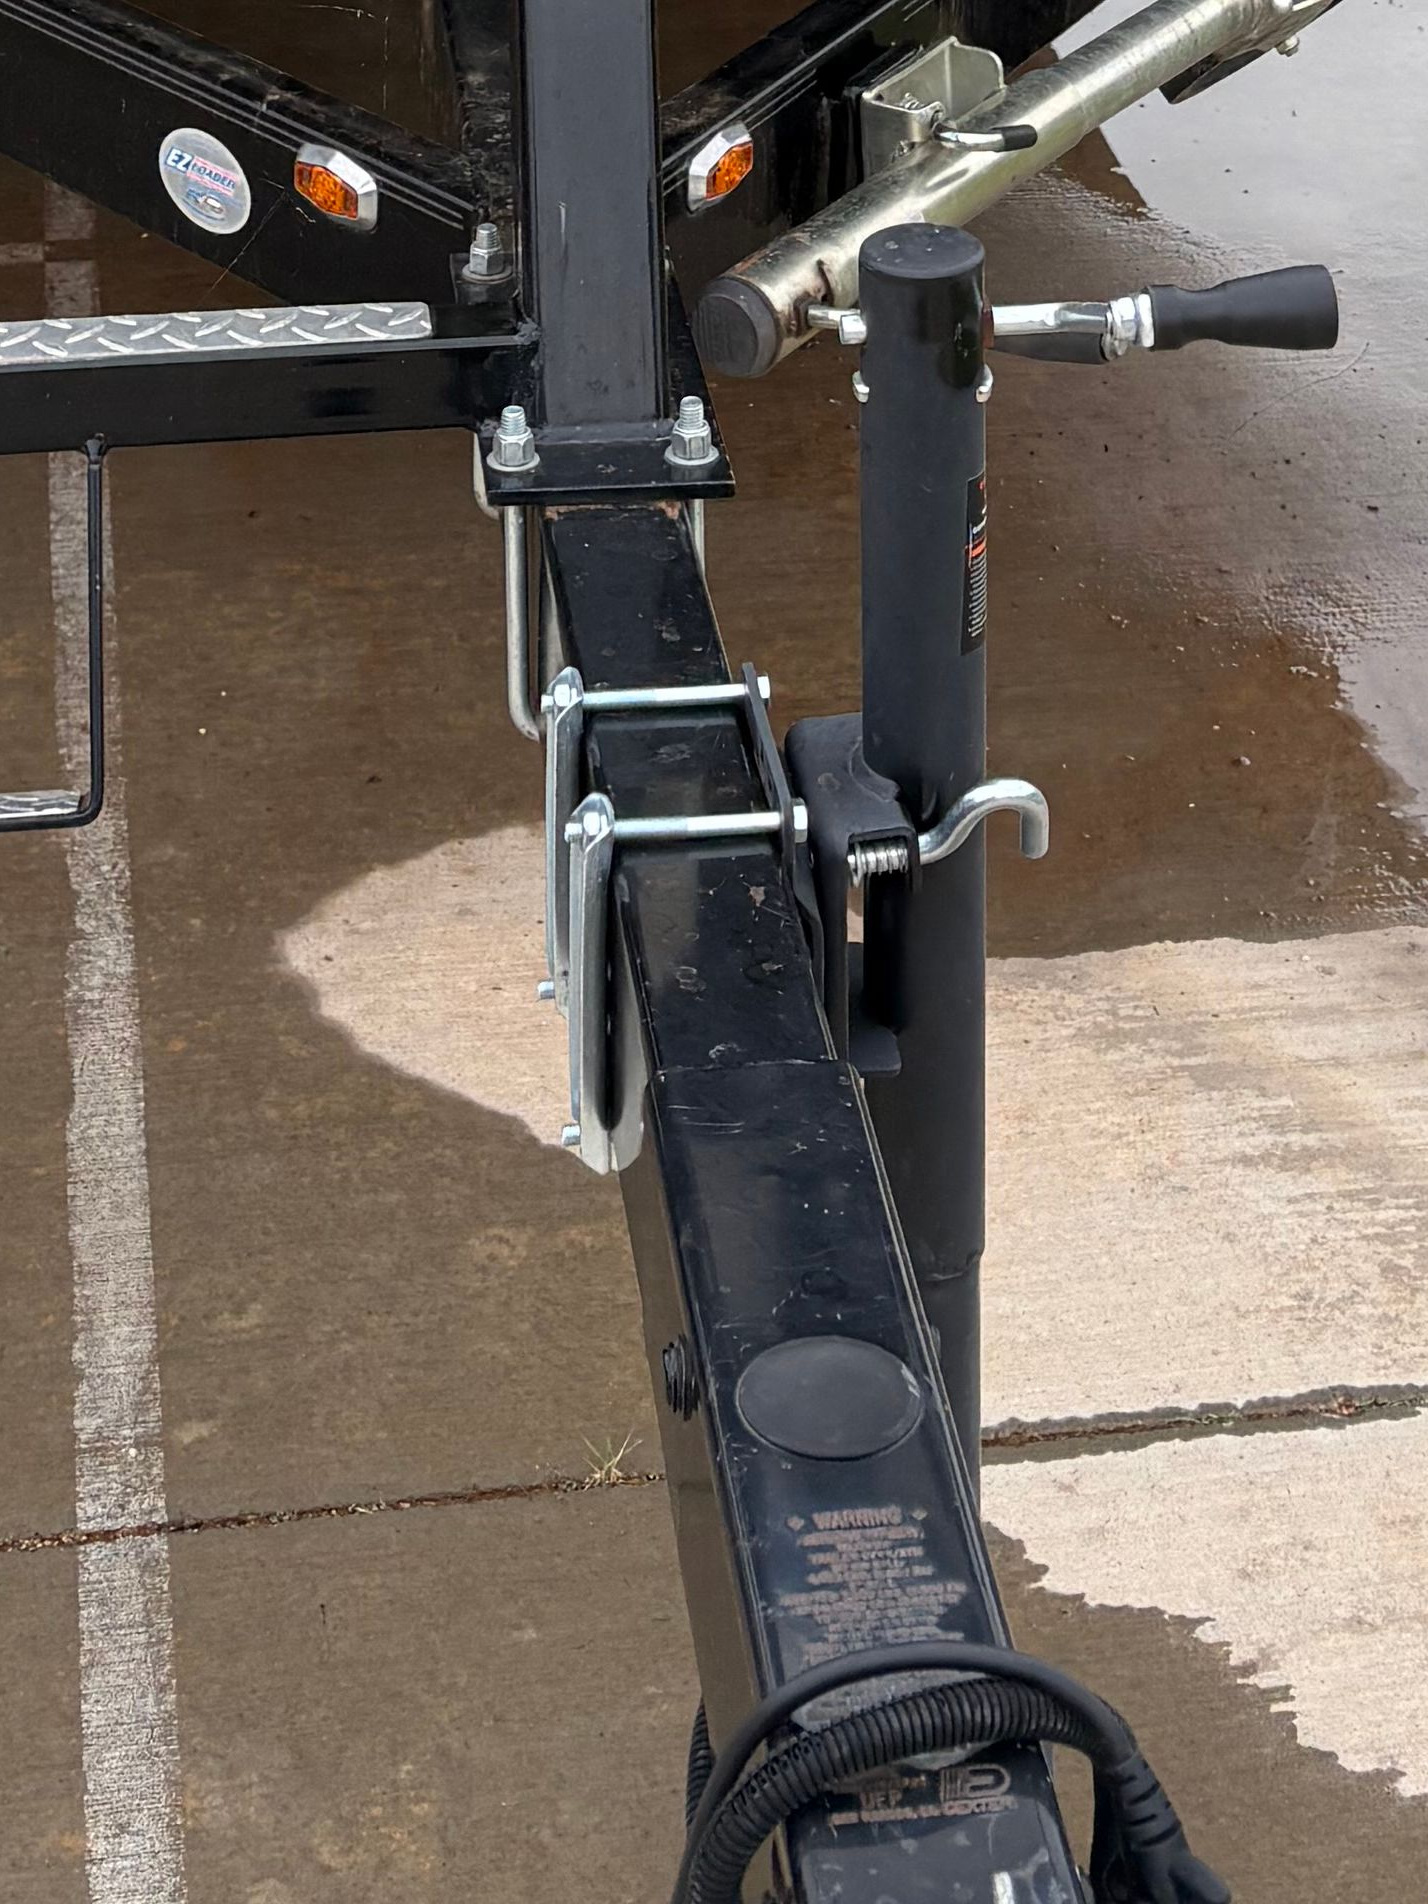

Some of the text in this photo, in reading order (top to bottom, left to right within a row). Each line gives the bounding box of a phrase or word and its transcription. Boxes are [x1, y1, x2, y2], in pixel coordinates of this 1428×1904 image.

[166, 148, 237, 190] EZ LOADER
[812, 1505, 902, 1530] WARNING
